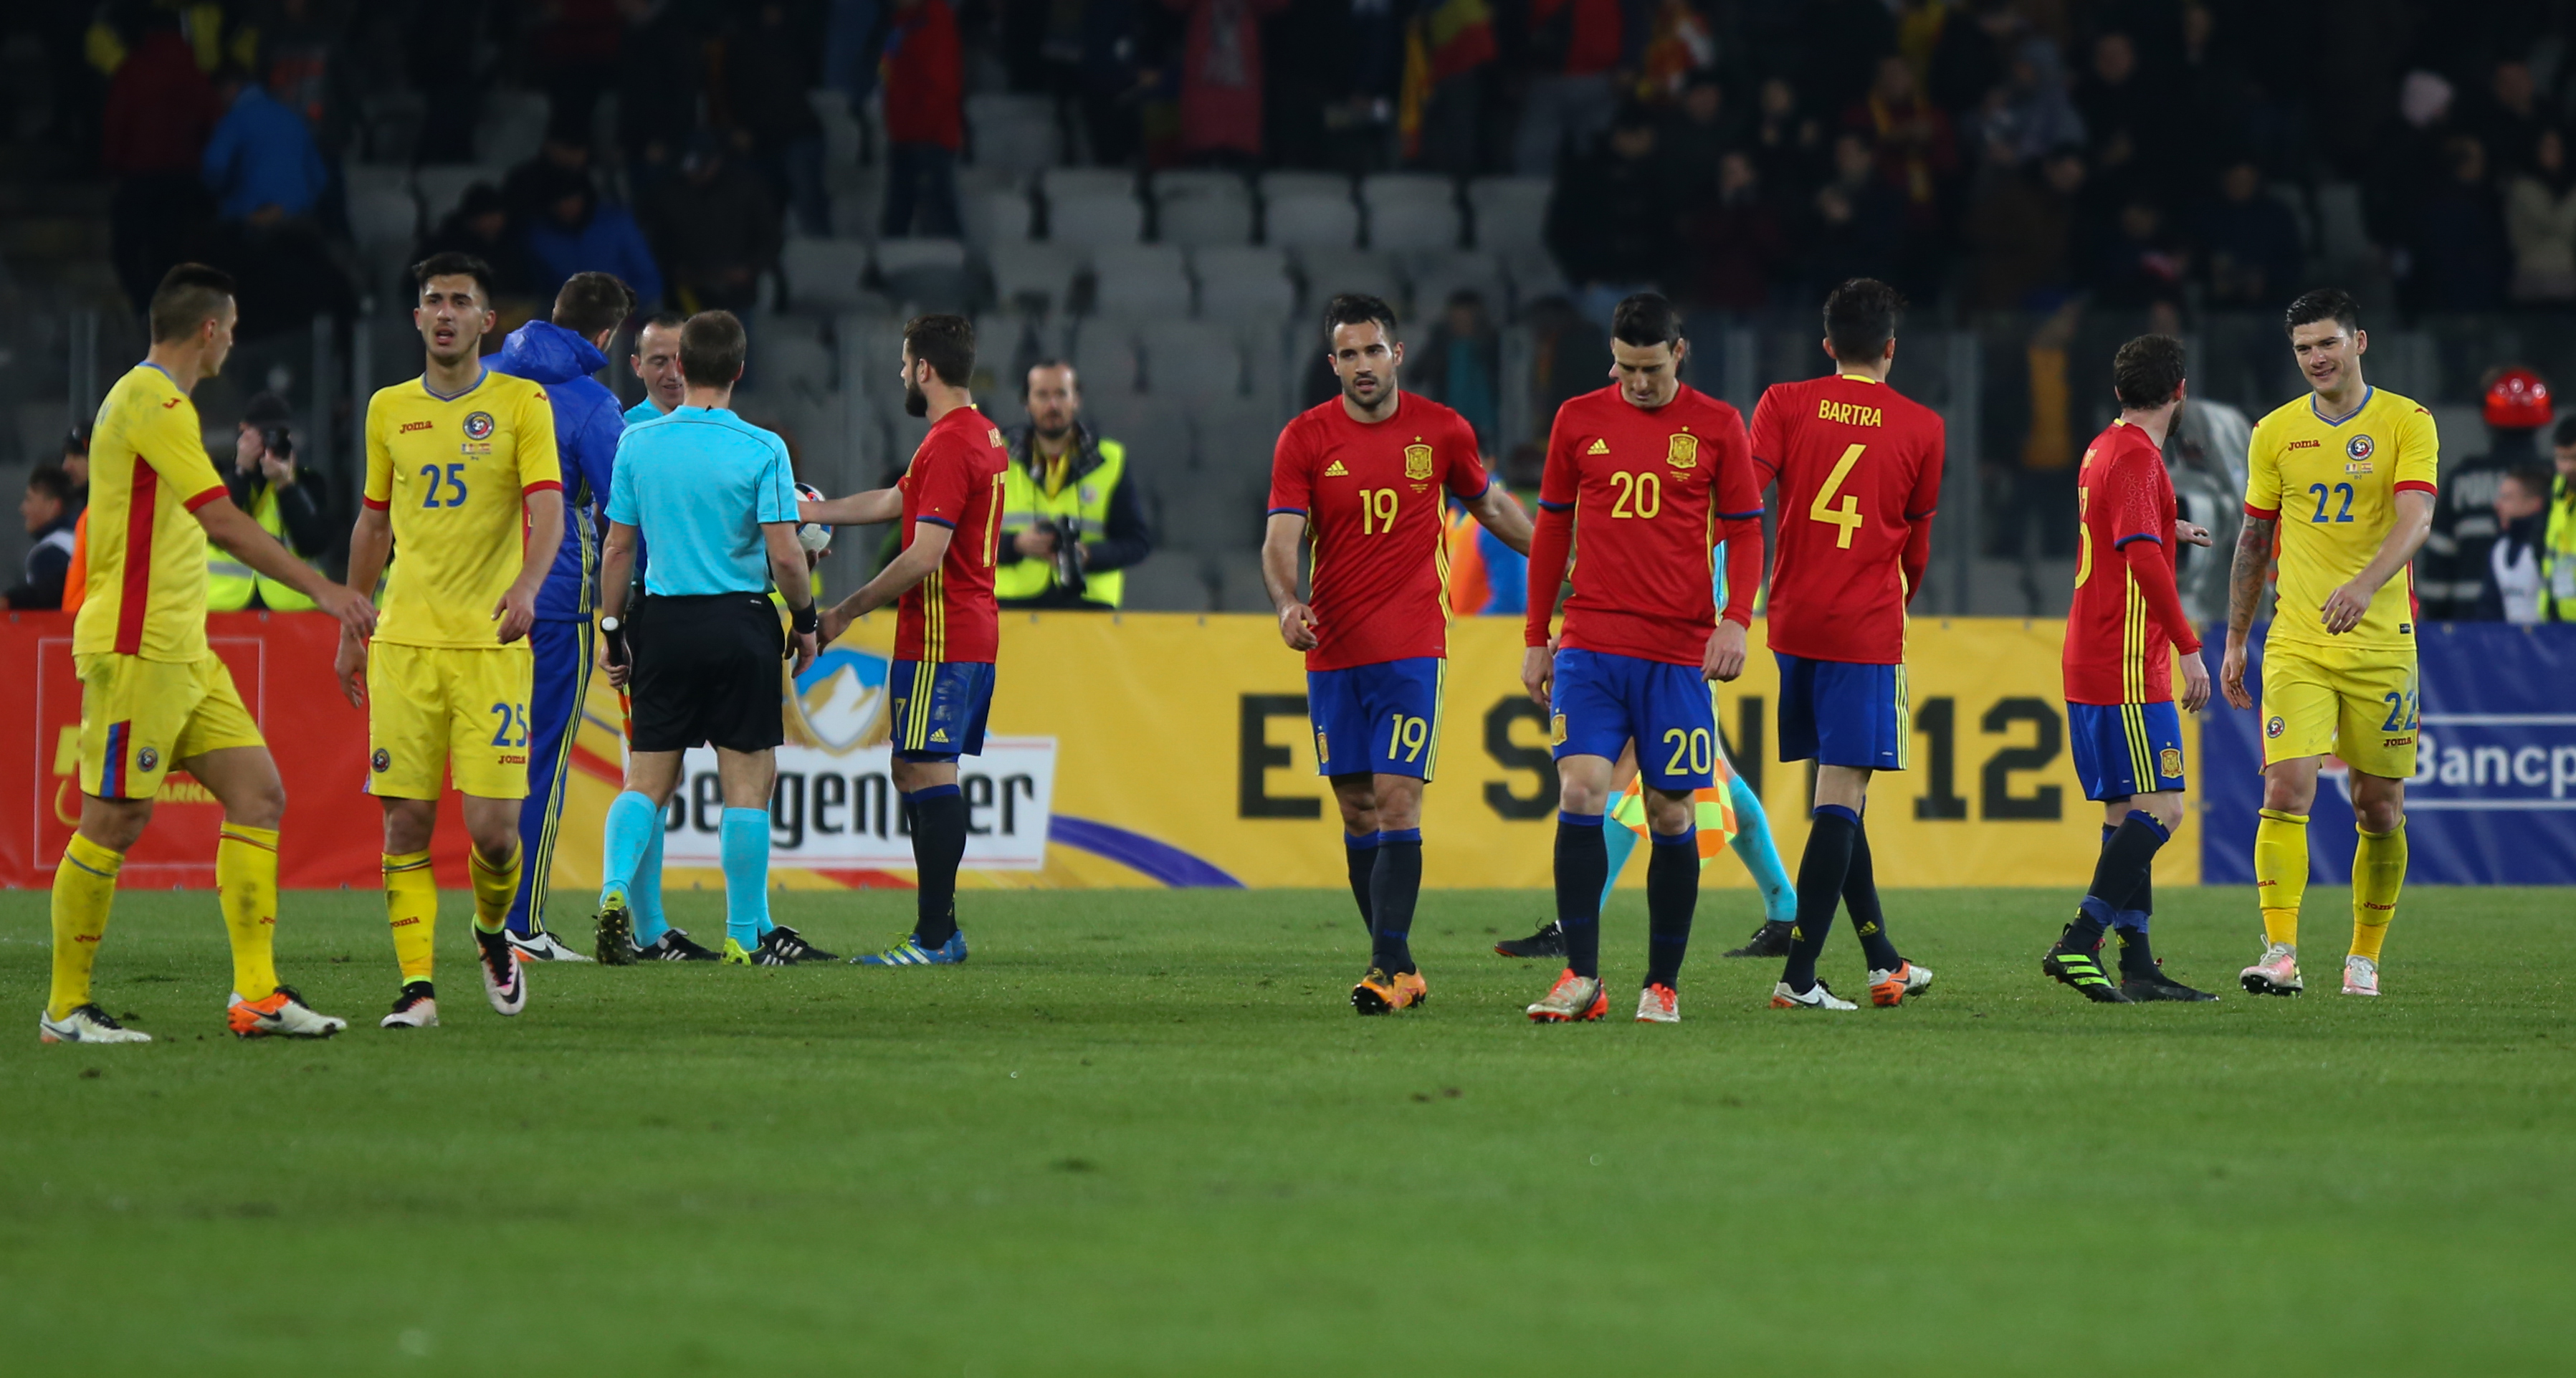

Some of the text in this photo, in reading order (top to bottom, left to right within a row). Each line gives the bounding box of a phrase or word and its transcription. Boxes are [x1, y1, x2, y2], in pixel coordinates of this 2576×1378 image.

[1818, 399, 1882, 428] BARTRA
[420, 463, 467, 508] 25
[1610, 470, 1661, 520] 20
[1809, 443, 1867, 550] 4
[2309, 482, 2355, 523] 22
[1359, 488, 1398, 535] 19
[490, 702, 527, 747] 25
[2381, 691, 2418, 731] 22
[1388, 714, 1427, 762] 19
[1663, 727, 1712, 776] 20
[1913, 696, 2063, 821] 12
